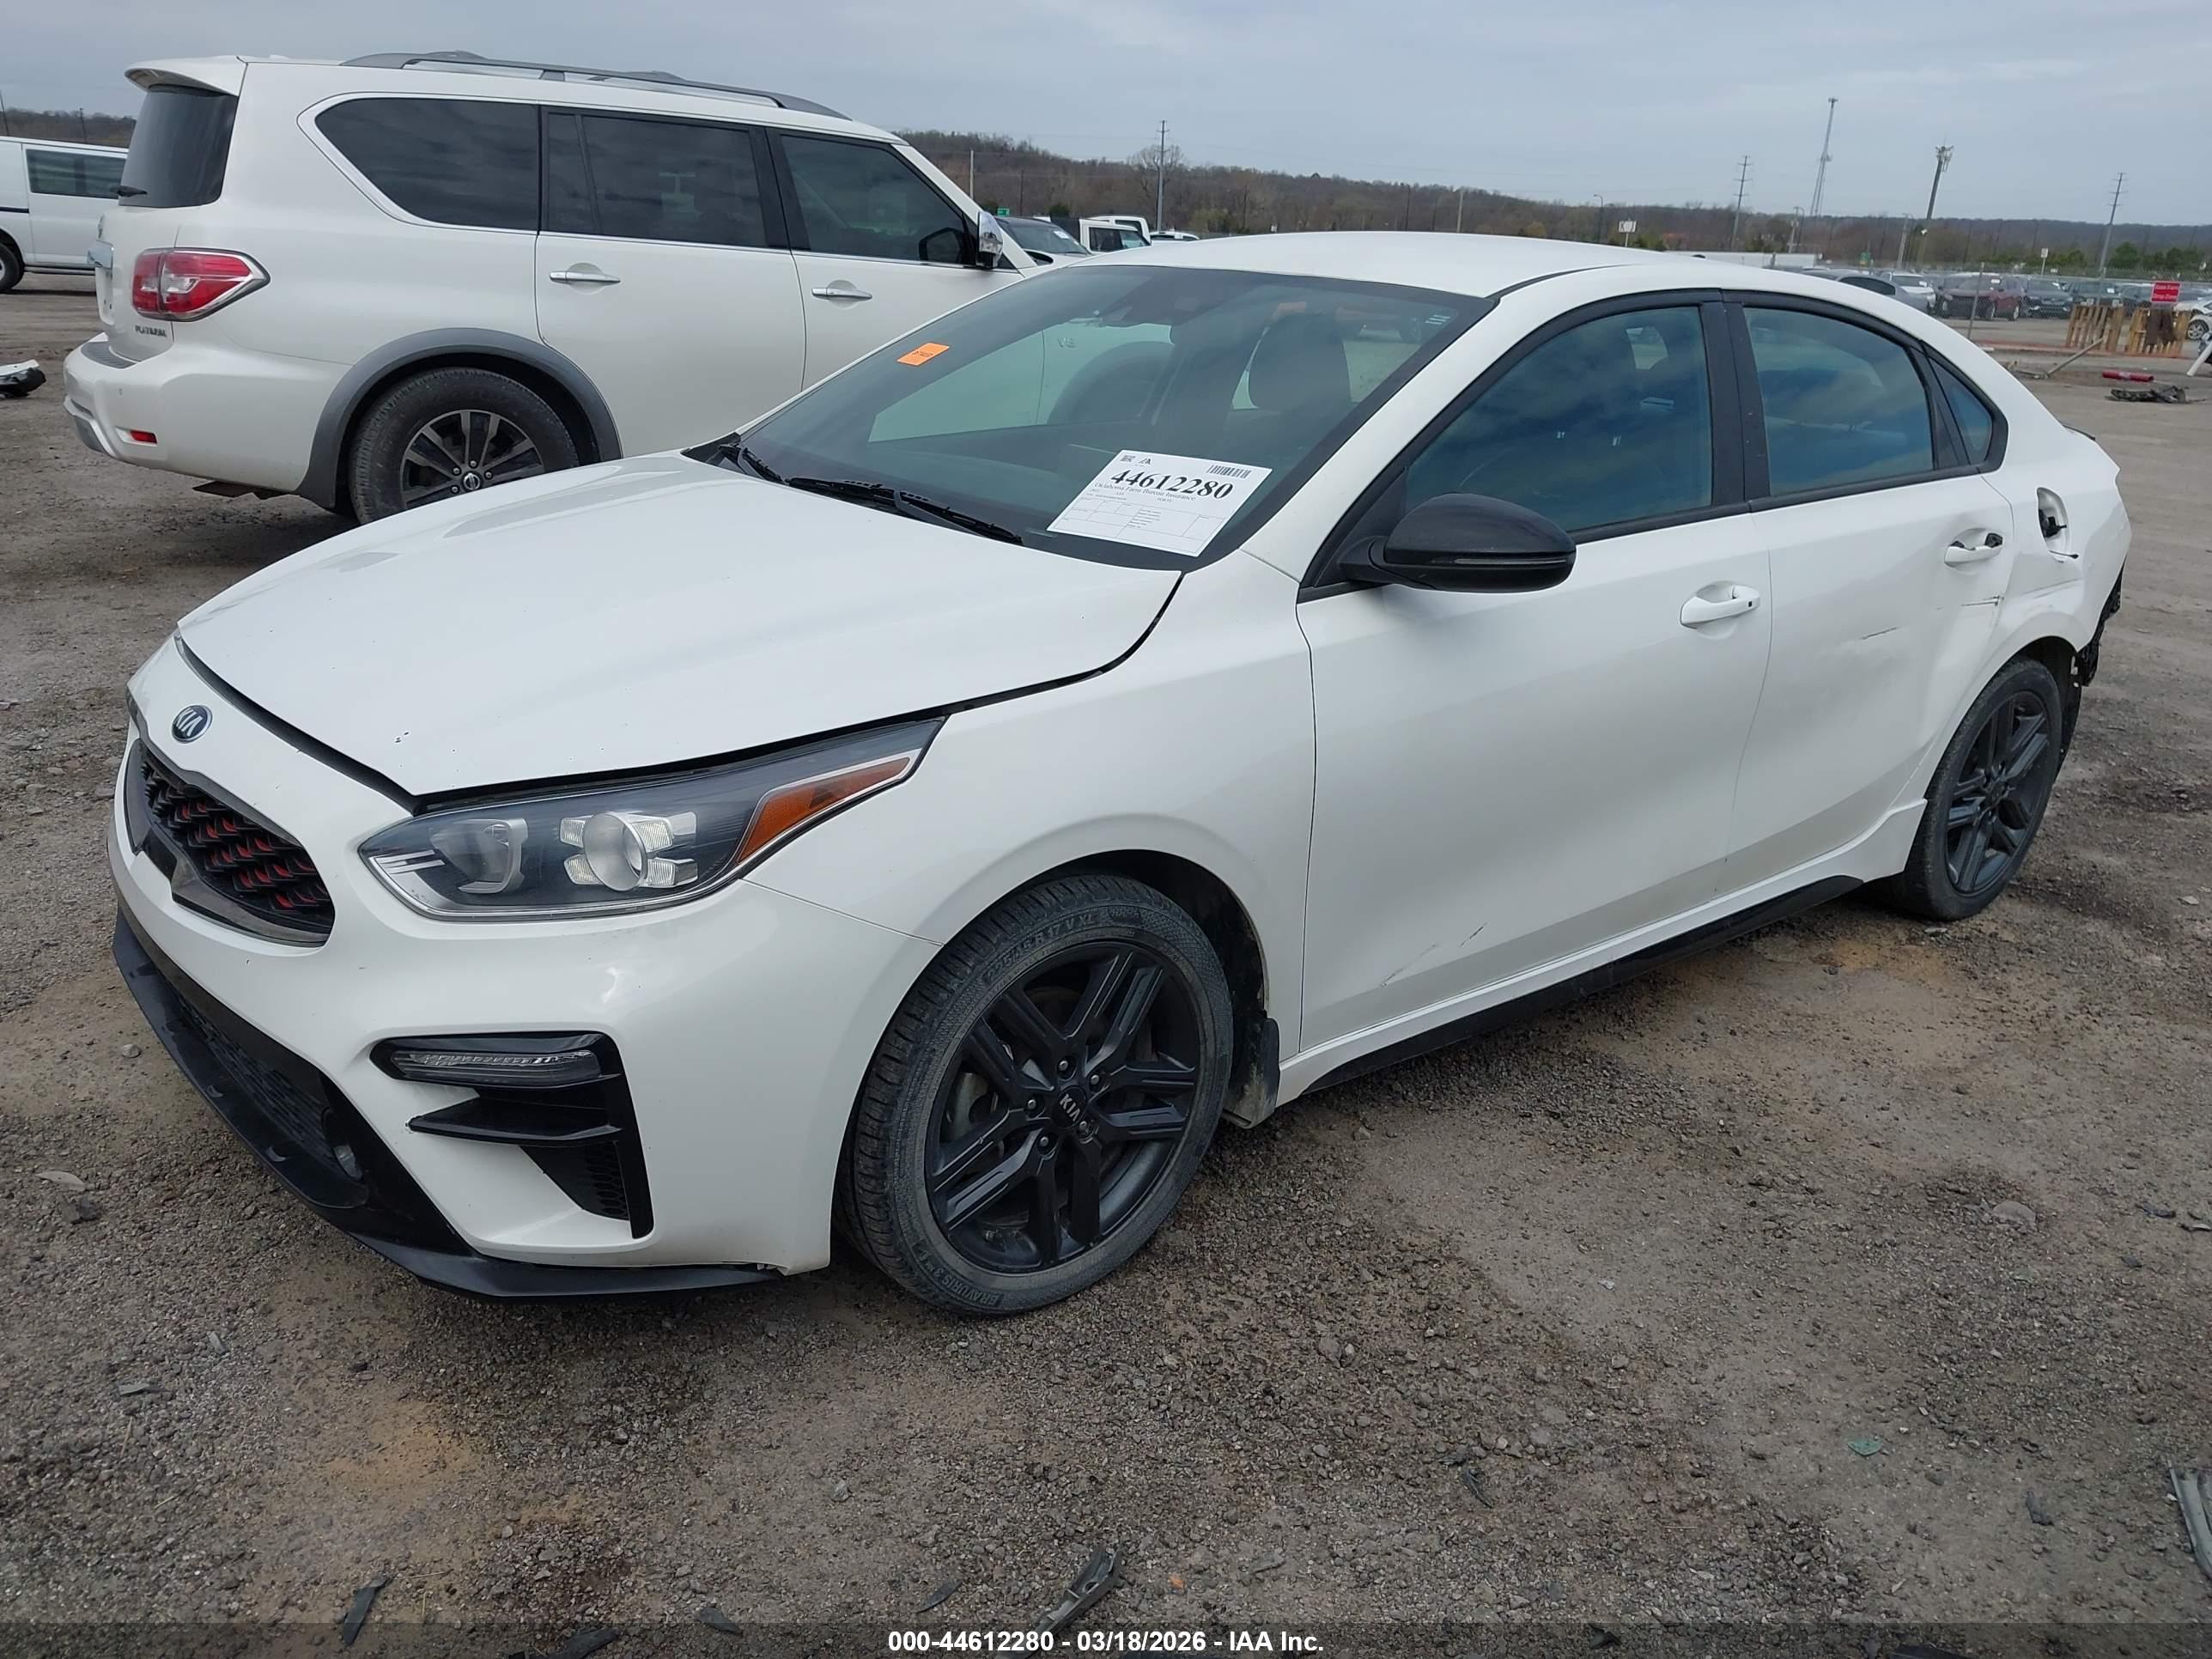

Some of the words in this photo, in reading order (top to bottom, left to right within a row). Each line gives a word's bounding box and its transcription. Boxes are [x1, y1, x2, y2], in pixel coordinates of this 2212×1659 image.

[1094, 482, 1125, 491] Oklahoma
[1125, 486, 1142, 495] Farm
[1142, 487, 1165, 497] Bureau
[1165, 492, 1196, 501] Insurance
[1110, 469, 1234, 500] 44612280
[1059, 1093, 1081, 1121] KIA
[941, 1274, 1001, 1306] BRAVURIS
